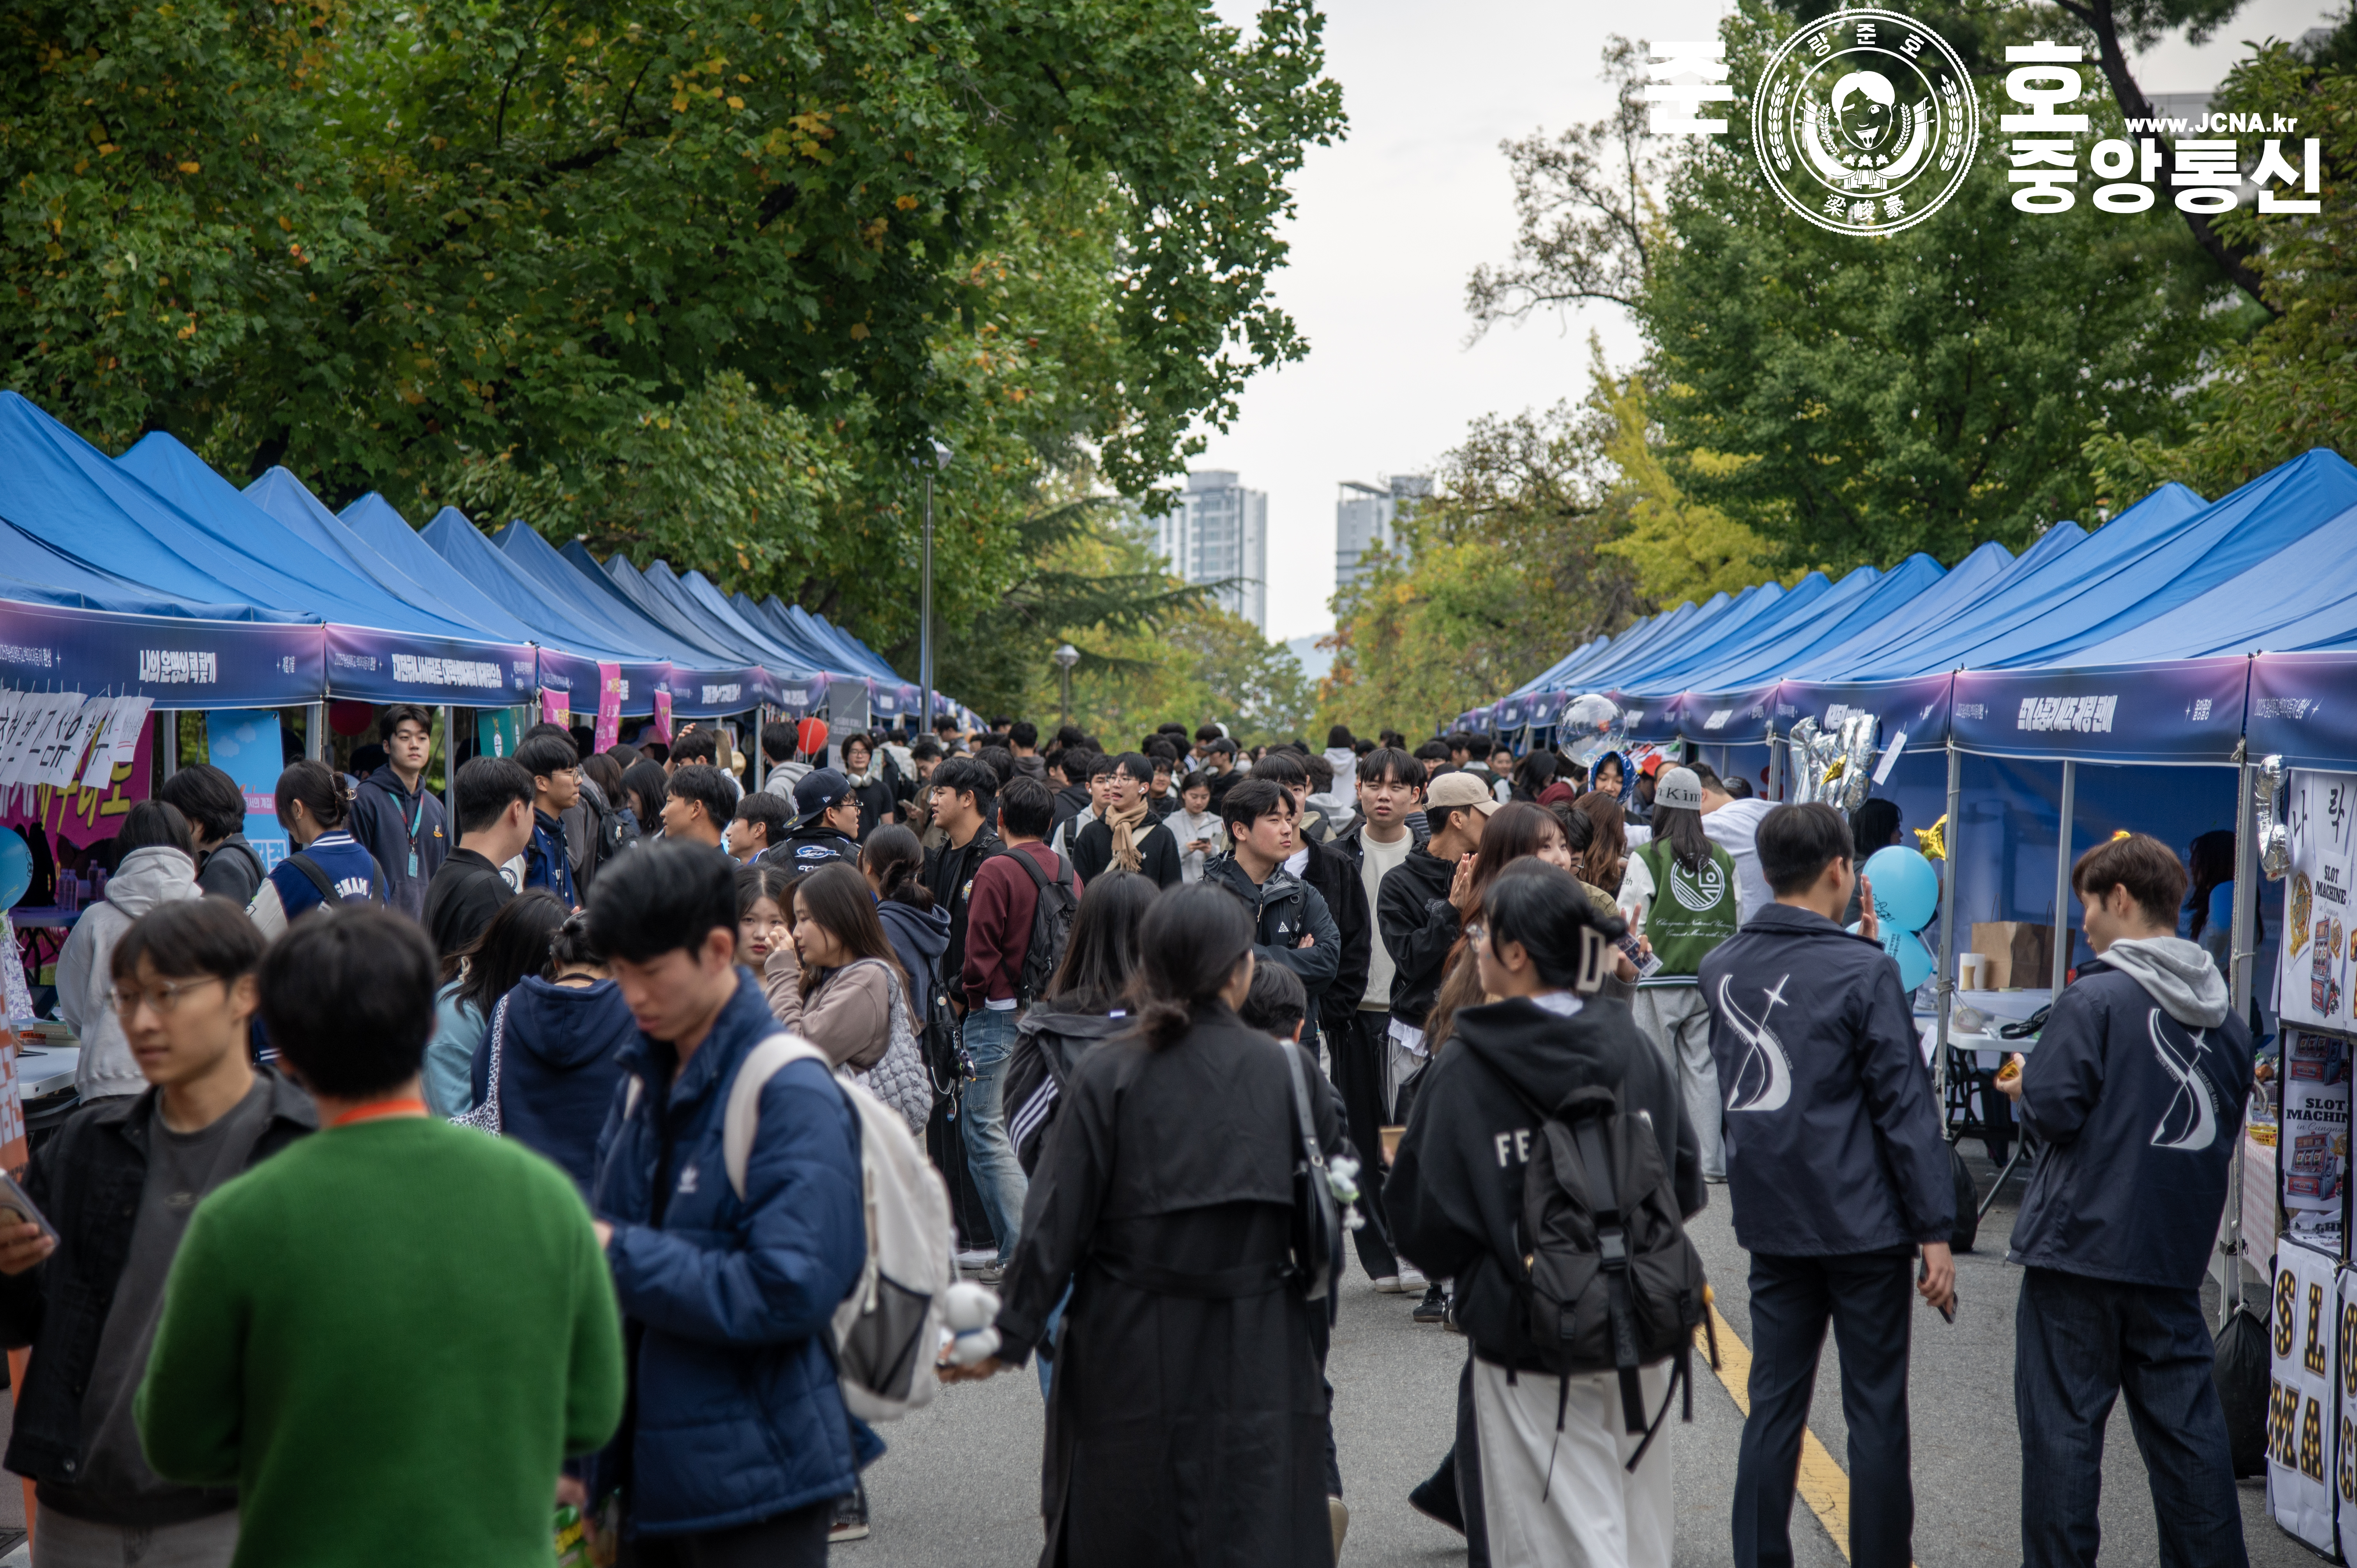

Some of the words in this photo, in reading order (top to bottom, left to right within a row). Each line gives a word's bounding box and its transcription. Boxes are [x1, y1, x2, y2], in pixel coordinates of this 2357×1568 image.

[43, 648, 52, 667] 환상
[139, 650, 160, 682] 나의
[160, 650, 189, 683] 운명의
[2193, 698, 2212, 721] 올망졸망
[2255, 699, 2267, 716] 2025
[2295, 698, 2312, 720] 환상
[261, 797, 272, 809] 계절
[1667, 788, 1700, 802] Kim
[2324, 865, 2340, 884] SLOT
[334, 877, 368, 899] GNAM
[2315, 881, 2346, 905] MACHINE
[1735, 1029, 1750, 1046] PATH
[1764, 1024, 1785, 1051] TIMELESS
[1783, 1050, 1793, 1071] MARK
[2155, 1052, 2168, 1071] NEW
[2165, 1065, 2180, 1083] PATH
[2194, 1065, 2215, 1094] TIMELESS
[2210, 1093, 2219, 1114] MARK
[2305, 1098, 2346, 1111] SLOT
[1494, 1129, 1531, 1167] FE
